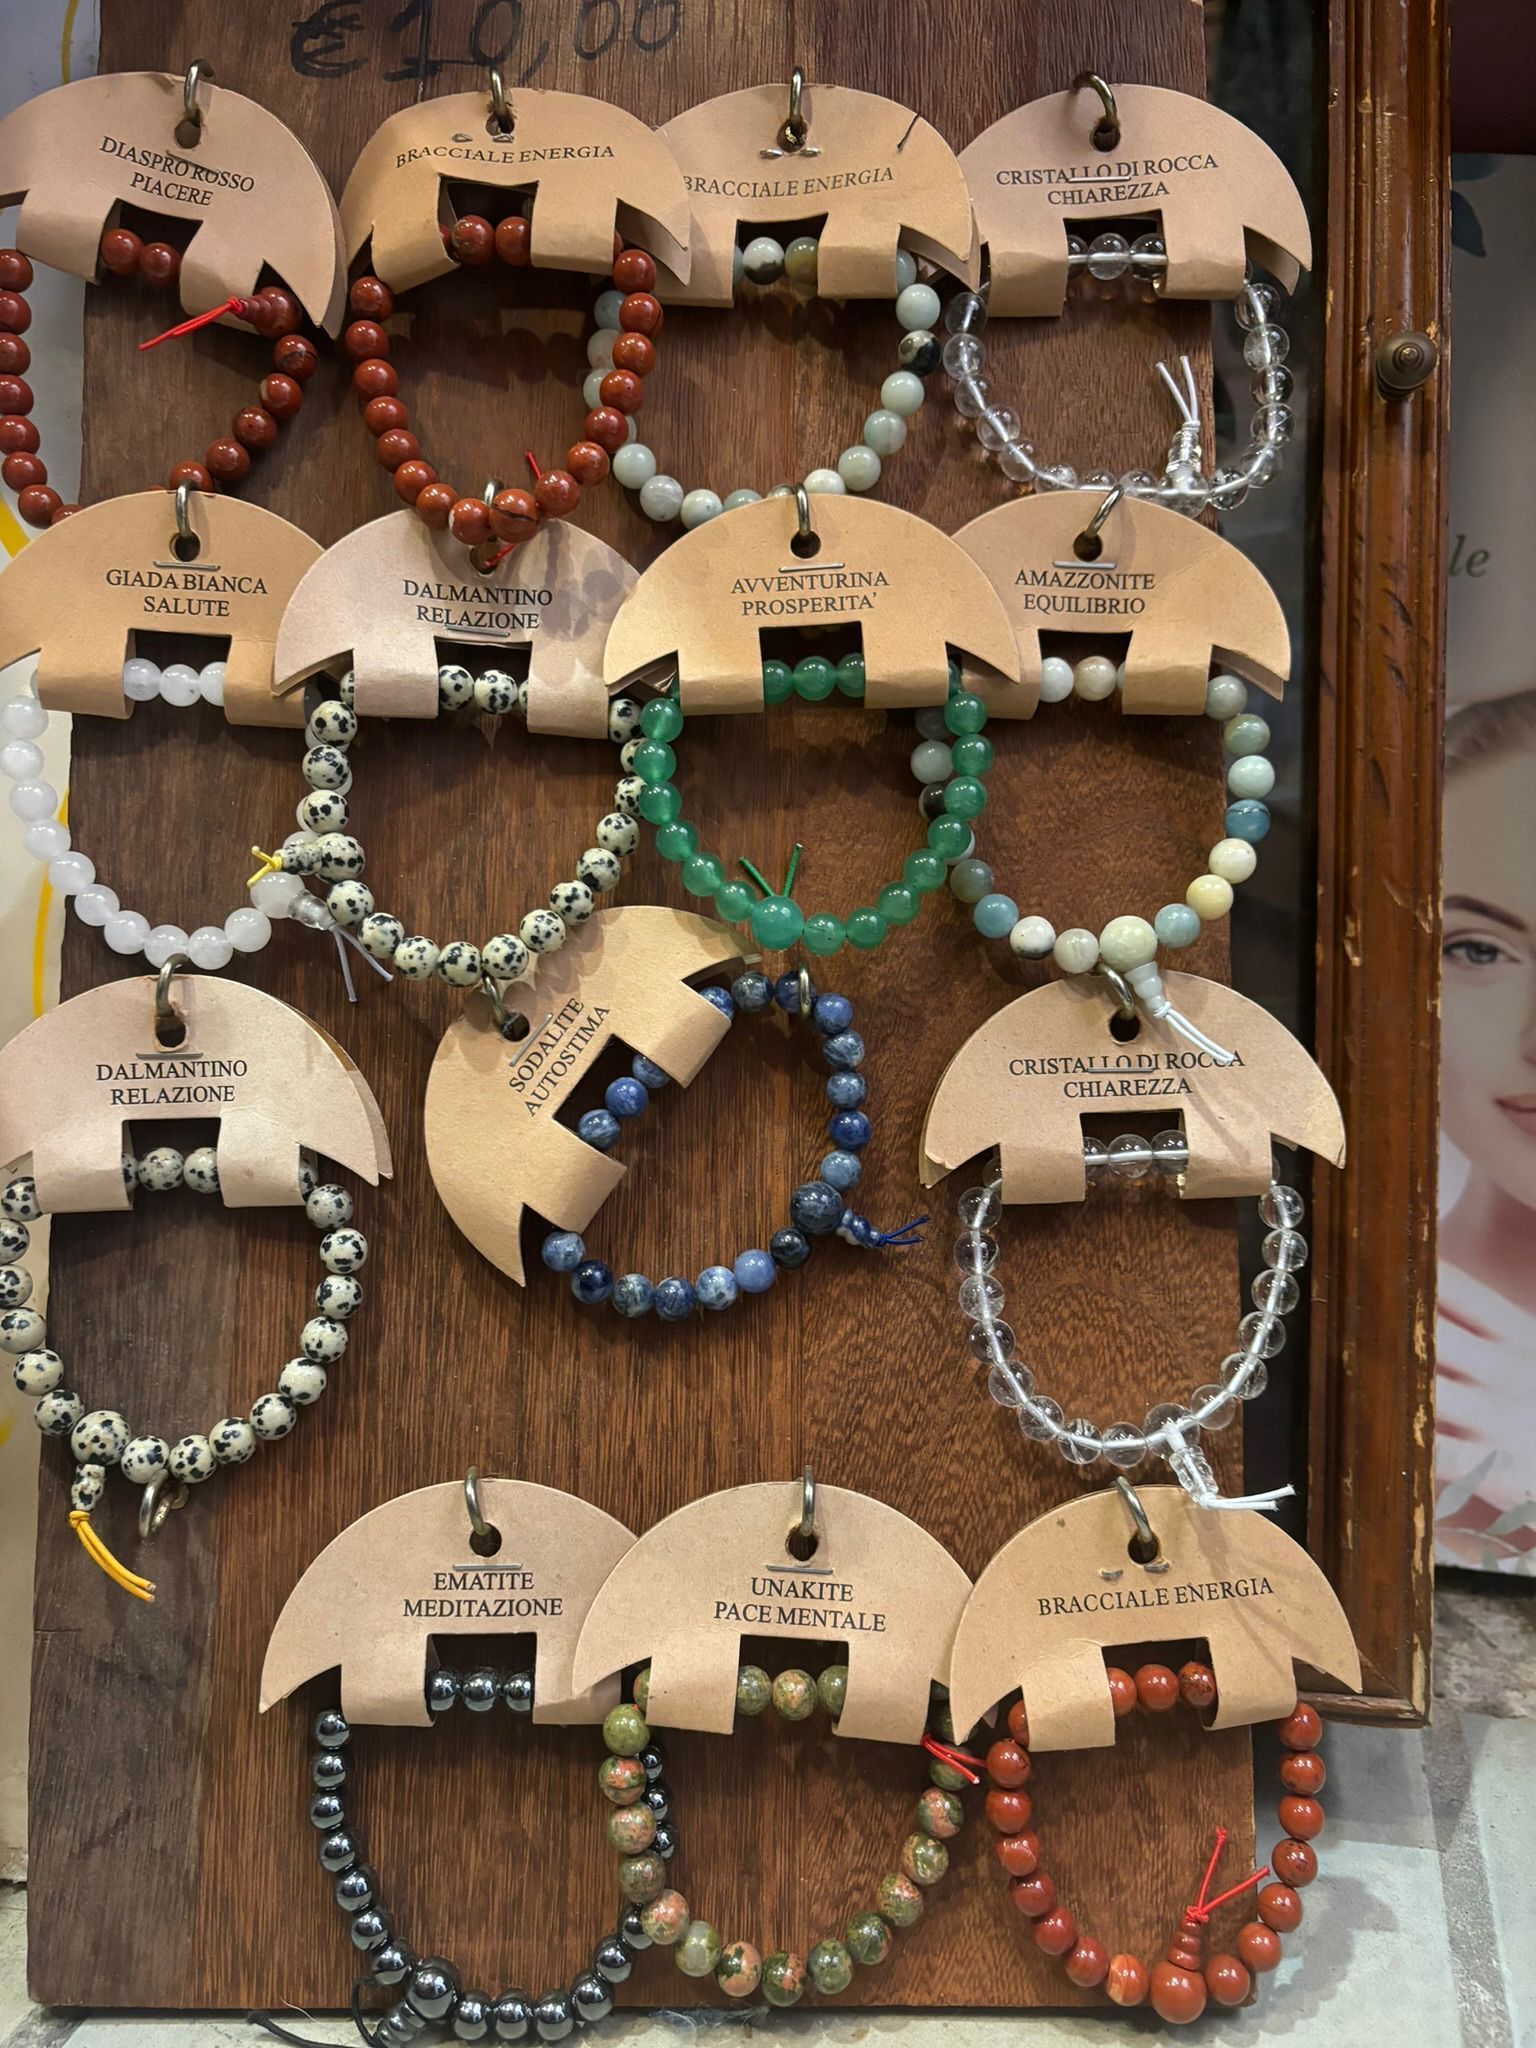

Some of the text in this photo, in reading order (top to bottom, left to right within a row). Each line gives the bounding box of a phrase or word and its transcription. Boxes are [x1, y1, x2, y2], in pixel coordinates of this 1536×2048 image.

[99, 136, 256, 193] DIASPRO ROSSO
[396, 145, 616, 168] BRACCIALE ENERGIA
[1116, 161, 1140, 178] DI
[1144, 153, 1219, 176] ROCCA
[129, 171, 215, 207] PIACERE
[682, 166, 895, 199] BRACCIALE ENERGIA
[1047, 181, 1171, 206] CHIAREZZA
[105, 569, 269, 595] GIADA BIANCA
[730, 571, 890, 594] AVVENTURINA
[1014, 569, 1156, 590] AMAZZONITE
[402, 579, 554, 606] DALMANTINO
[1023, 593, 1146, 615] EQUILIBRIO
[143, 596, 231, 617] SALUTE
[415, 604, 540, 630] RELAZIONE
[508, 997, 585, 1093] SODALITE
[95, 1059, 248, 1082] DALMANTINO
[524, 1006, 611, 1117] AUTOSTIMA
[1136, 1053, 1161, 1071] DI
[110, 1085, 236, 1106] RELAZIONE
[1063, 1077, 1194, 1099] CHIAREZZA
[433, 1572, 536, 1591] EMATITE
[750, 1577, 854, 1603] UNAKITE
[403, 1598, 564, 1618] MEDITAZIONE
[1037, 1576, 1275, 1617] BRACCIALE ENERGIA
[713, 1600, 887, 1633] PACE MENTALE
